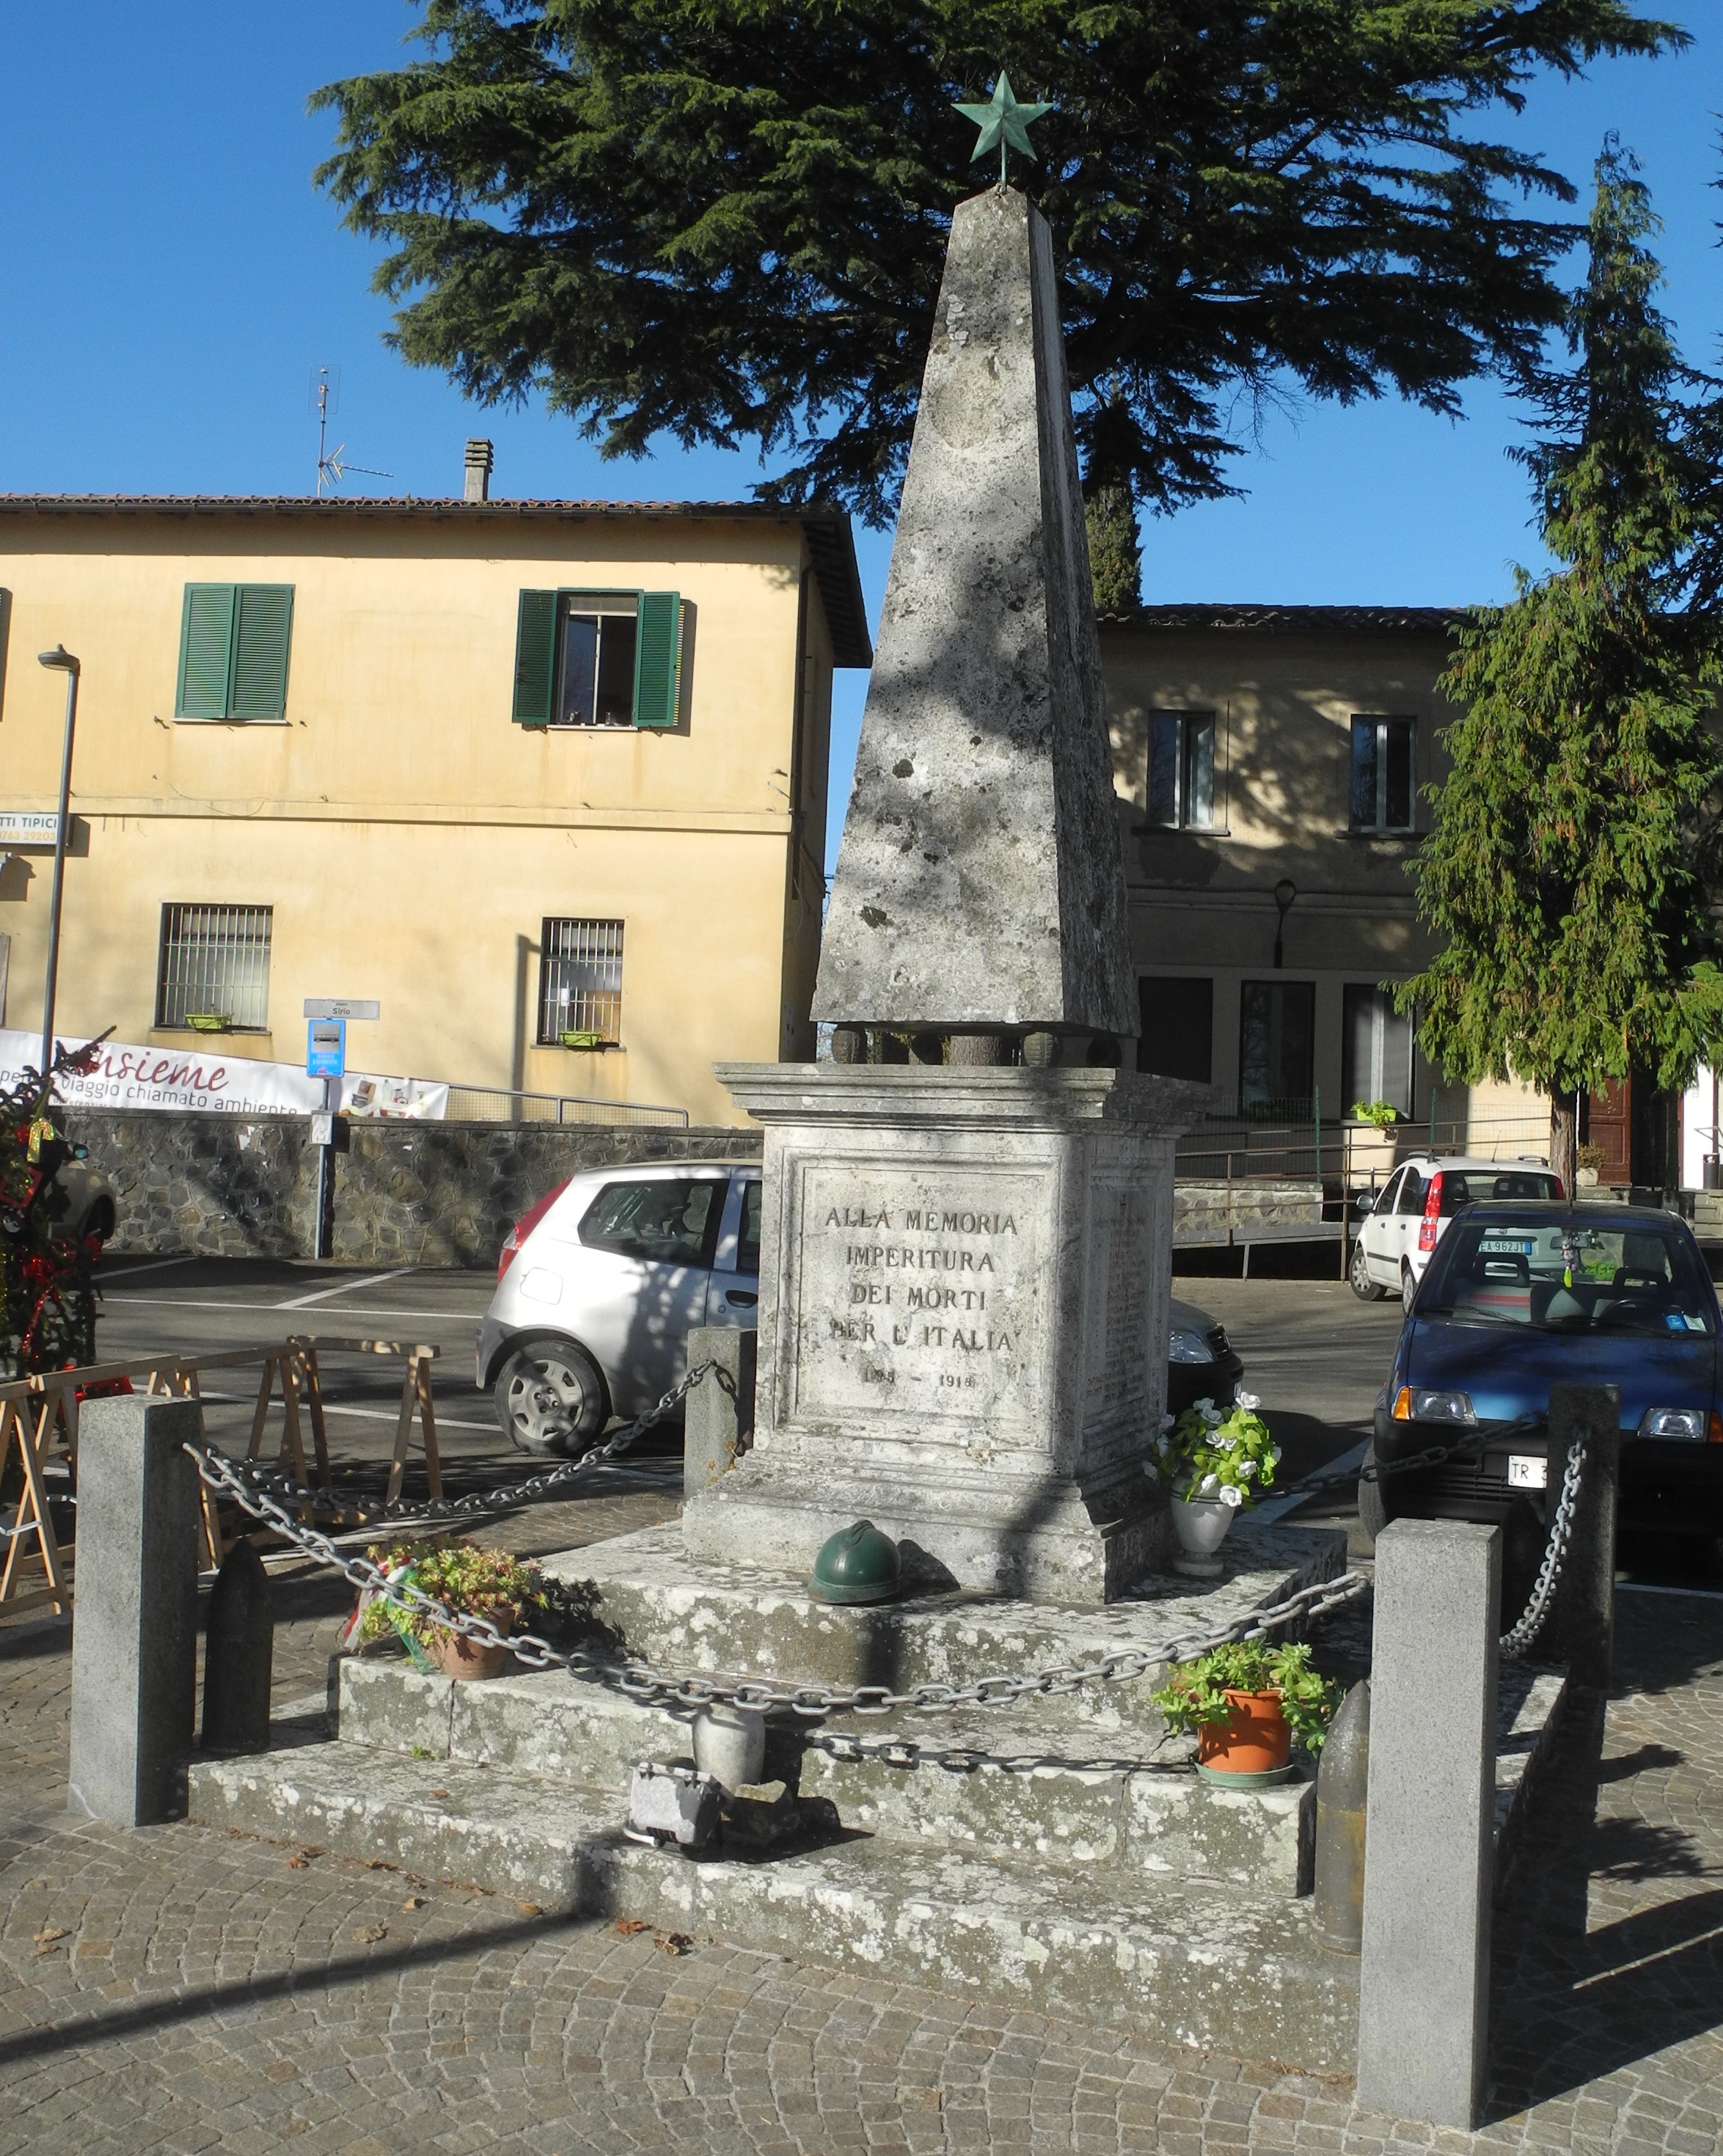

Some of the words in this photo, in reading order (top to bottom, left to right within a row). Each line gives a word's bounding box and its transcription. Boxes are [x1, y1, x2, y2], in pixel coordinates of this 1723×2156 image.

[22, 818, 56, 828] TIPICI
[0, 830, 20, 840] 763
[23, 831, 56, 841] 29203
[96, 1050, 229, 1092] nsieme
[126, 1084, 207, 1107] chiamato
[825, 1207, 891, 1229] ALLA
[906, 1210, 1017, 1235] MEMORIA
[1481, 1242, 1492, 1251] EA
[846, 1246, 995, 1272] IMPERITURA
[851, 1284, 891, 1304] DEI
[907, 1287, 985, 1310] MORTI
[830, 1320, 877, 1342] PER
[923, 1326, 1012, 1351] ITALIA
[939, 1374, 973, 1388] 1918
[1512, 1463, 1529, 1479] TR
